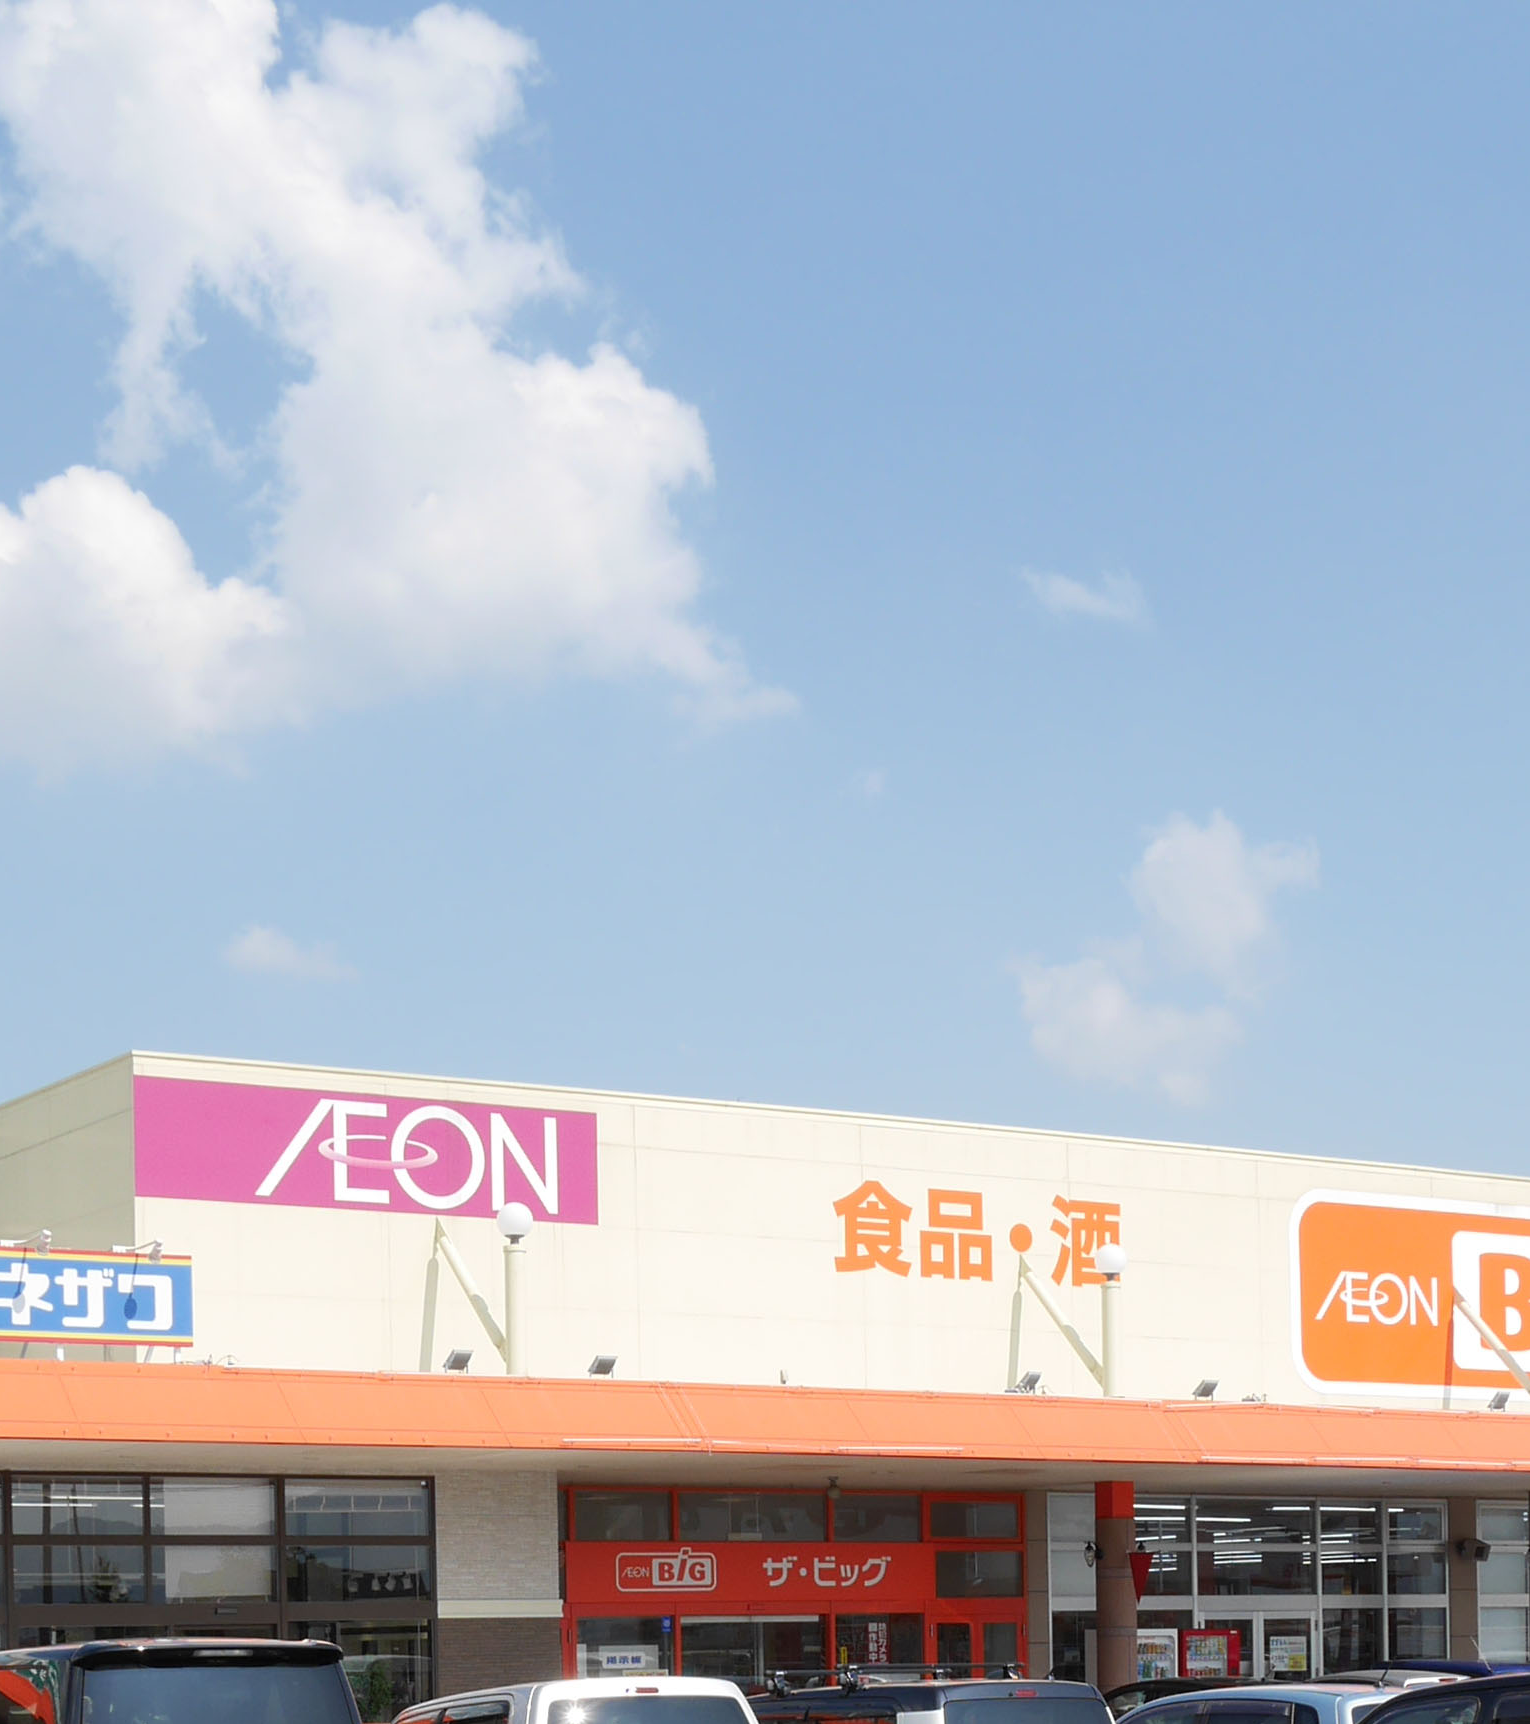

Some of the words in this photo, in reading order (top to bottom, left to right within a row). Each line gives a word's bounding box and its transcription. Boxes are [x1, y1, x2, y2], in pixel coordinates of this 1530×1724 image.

[762, 1555, 892, 1588] ザ・ビッグ
